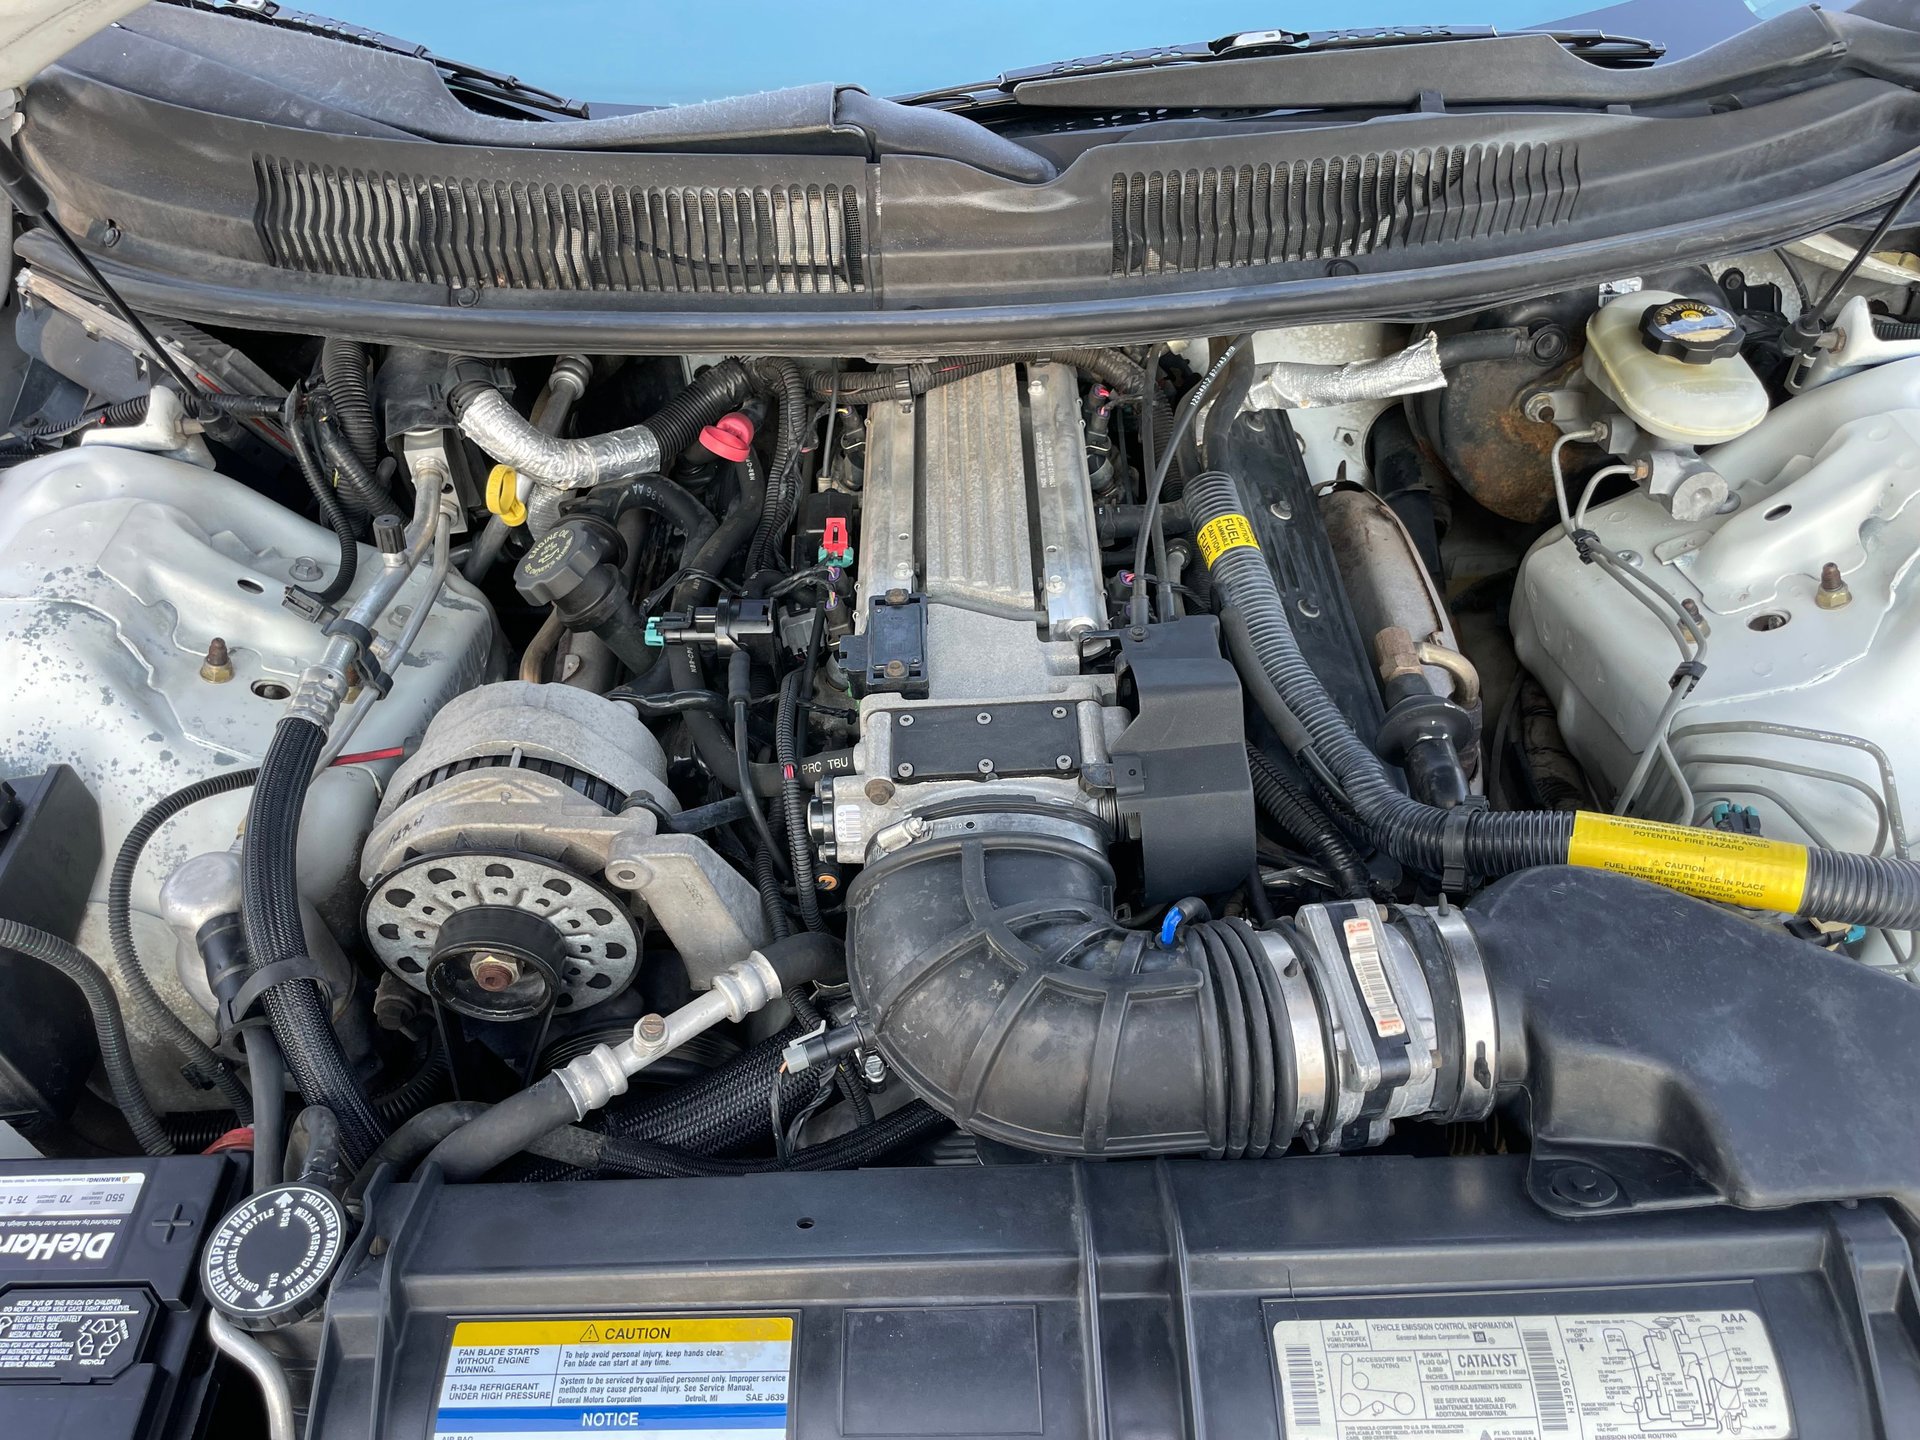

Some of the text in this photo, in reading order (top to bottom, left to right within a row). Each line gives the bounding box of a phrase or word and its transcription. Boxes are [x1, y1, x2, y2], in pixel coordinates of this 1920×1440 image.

[1222, 518, 1240, 544] FUEL
[1200, 532, 1212, 559] FUEL
[1206, 524, 1221, 553] CAUTION
[801, 756, 849, 775] PRC TBU
[837, 811, 847, 839] 5236
[1633, 830, 1682, 842] POTENTIAL
[1684, 836, 1705, 845] FIRE
[1706, 840, 1745, 851] HAZARD
[1669, 828, 1699, 837] STRAP
[1741, 840, 1771, 849] AVOID
[1664, 861, 1705, 873] CAUTION
[1604, 861, 1627, 870] FUEL
[1628, 864, 1654, 874] LINES
[1655, 867, 1680, 877] MUST
[1680, 871, 1696, 880] BE
[1723, 878, 1734, 886] IN
[1735, 880, 1766, 891] PLACE
[1662, 876, 1692, 887] STRAP
[1694, 881, 1708, 889] TO
[1709, 884, 1733, 893] HELP
[1735, 888, 1763, 898] AVOID
[1698, 889, 1737, 899] HAZARD
[60, 1194, 73, 1204] 70
[105, 1193, 125, 1202] 550
[280, 1208, 291, 1228] RC94
[0, 1232, 116, 1261] DieHar
[210, 1203, 258, 1304] NEVER OPEN HOT
[227, 1208, 275, 1292] CHECK LEVEL IN BOTTLE
[281, 1206, 321, 1287] 18 LB CLOSED SYSTEM
[284, 1192, 337, 1301] ALIGN ARROW & VENT TUBE
[1721, 1313, 1748, 1323] AAA
[79, 1319, 93, 1333] LEAD
[604, 1326, 671, 1340] CAUTION
[1335, 1322, 1354, 1330] AAA
[1371, 1321, 1514, 1332] VEHICLE EMISSION CONTROL INFORMATION
[458, 1347, 540, 1357] FAN BLADE STARTS
[565, 1349, 725, 1360] To help avoid personal injury, keep hands clear.
[457, 1356, 530, 1365] WITHOUT ENGINE
[563, 1360, 576, 1368] Fan
[578, 1359, 596, 1367] blade
[613, 1359, 629, 1367] start
[631, 1359, 638, 1367] at
[640, 1360, 652, 1369] any
[654, 1358, 671, 1366] time.
[1457, 1353, 1518, 1369] CATALYST
[455, 1365, 496, 1374] RUNNING.
[451, 1382, 540, 1391] R-134a REFRIGERANT
[560, 1374, 786, 1387] System to be serviced by qualified personnel only. Improper service
[1555, 1359, 1575, 1415] 57V8GFEH
[449, 1391, 551, 1400] UNDER HIGH PRESSURE
[558, 1385, 588, 1394] methods
[589, 1387, 604, 1396] may
[629, 1385, 658, 1394] personal
[660, 1384, 681, 1394] injury.
[683, 1384, 697, 1392] See
[699, 1384, 725, 1392] Service
[727, 1383, 755, 1391] Manual.
[557, 1393, 785, 1405] General Motors Corporation Detroit, MI SAE J639
[581, 1411, 640, 1426] NOTICE
